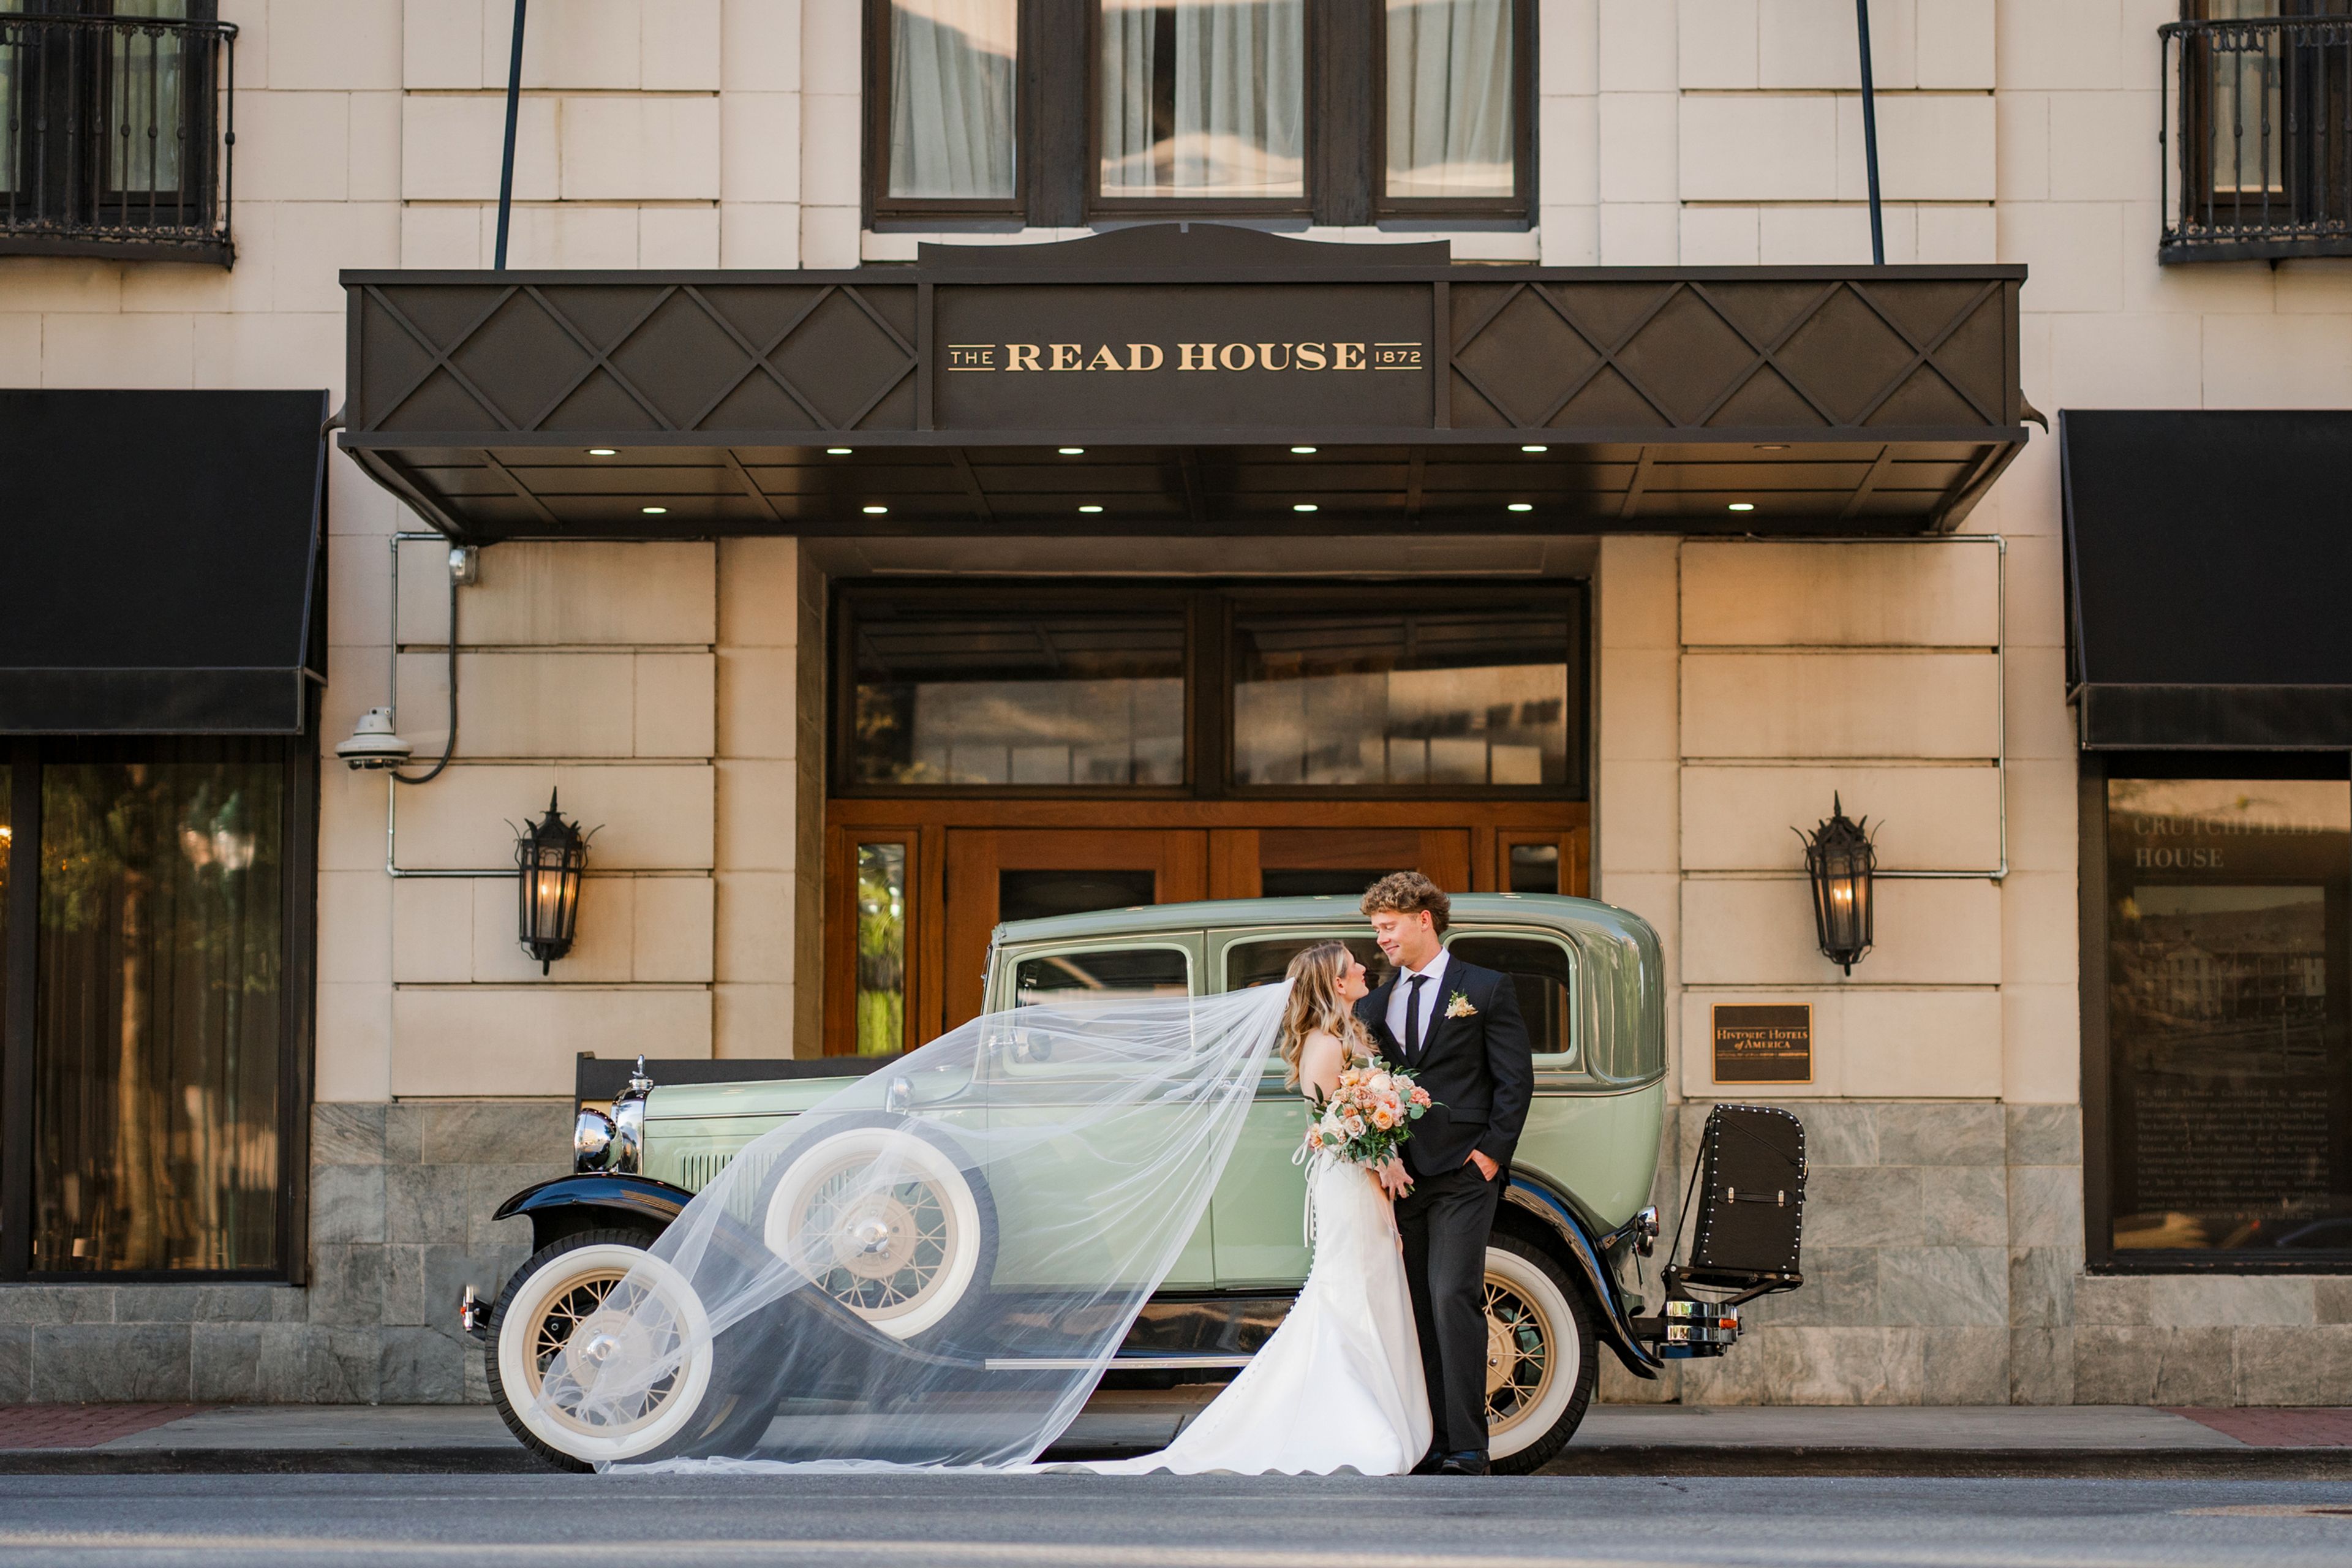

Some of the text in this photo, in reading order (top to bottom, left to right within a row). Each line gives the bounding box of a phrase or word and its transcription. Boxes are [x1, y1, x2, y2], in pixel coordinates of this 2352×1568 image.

[951, 343, 1420, 371] THE READ HOUSE 1872
[2135, 848, 2224, 868] HOUSE
[1717, 1029, 1808, 1039] HISTORIC HOTELS
[1735, 1039, 1790, 1050] of AMERICA
